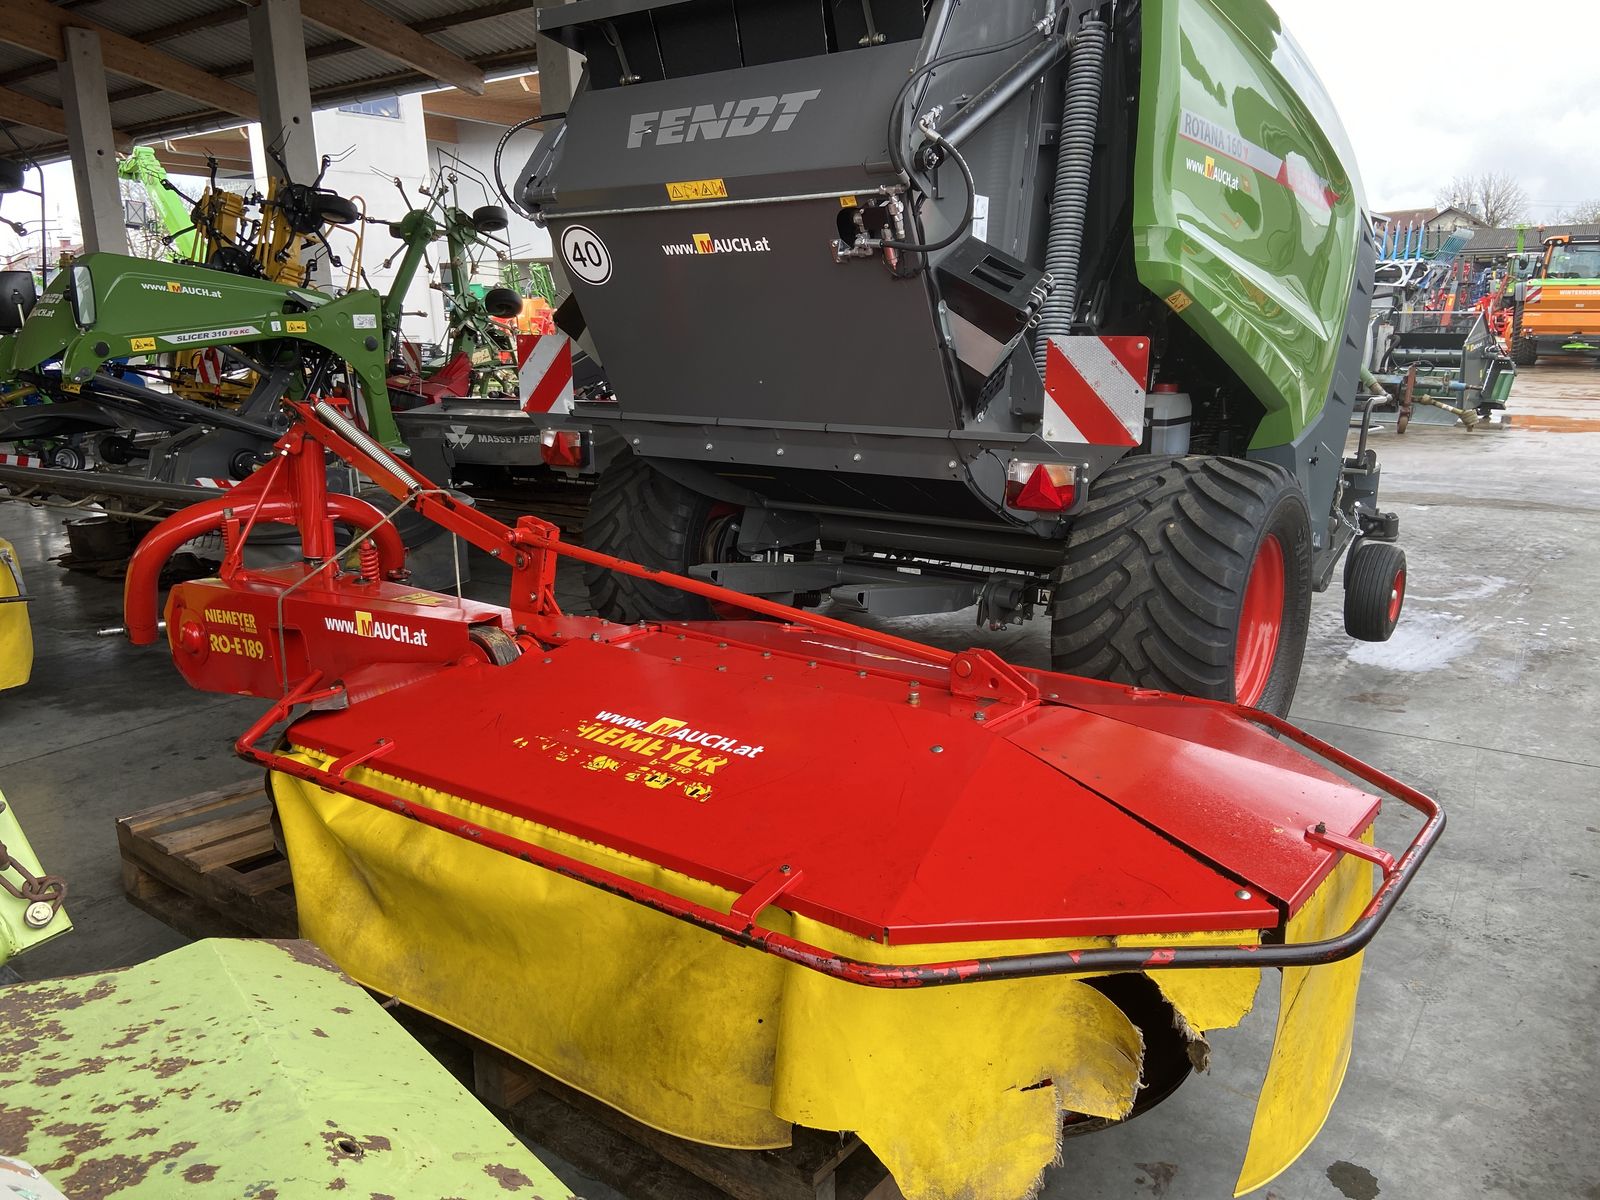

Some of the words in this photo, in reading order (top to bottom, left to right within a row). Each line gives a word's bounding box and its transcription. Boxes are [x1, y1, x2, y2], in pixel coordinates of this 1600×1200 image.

[626, 88, 822, 149] FENDT
[1184, 113, 1225, 149] ROTANA
[1226, 132, 1243, 157] 160
[1185, 156, 1240, 191] www.MAUCH.at
[571, 239, 602, 268] 40
[662, 234, 771, 256] www.MAUCH.at
[141, 281, 223, 299] www.MAUCH.at
[176, 332, 211, 343] SLICER
[211, 329, 228, 339] 310
[477, 434, 516, 444] MASSEY
[204, 608, 258, 629] NIEMEYER
[324, 615, 428, 647] www.MAUCH.at
[243, 639, 264, 660] 189
[595, 710, 765, 759] www.MAUCH.at
